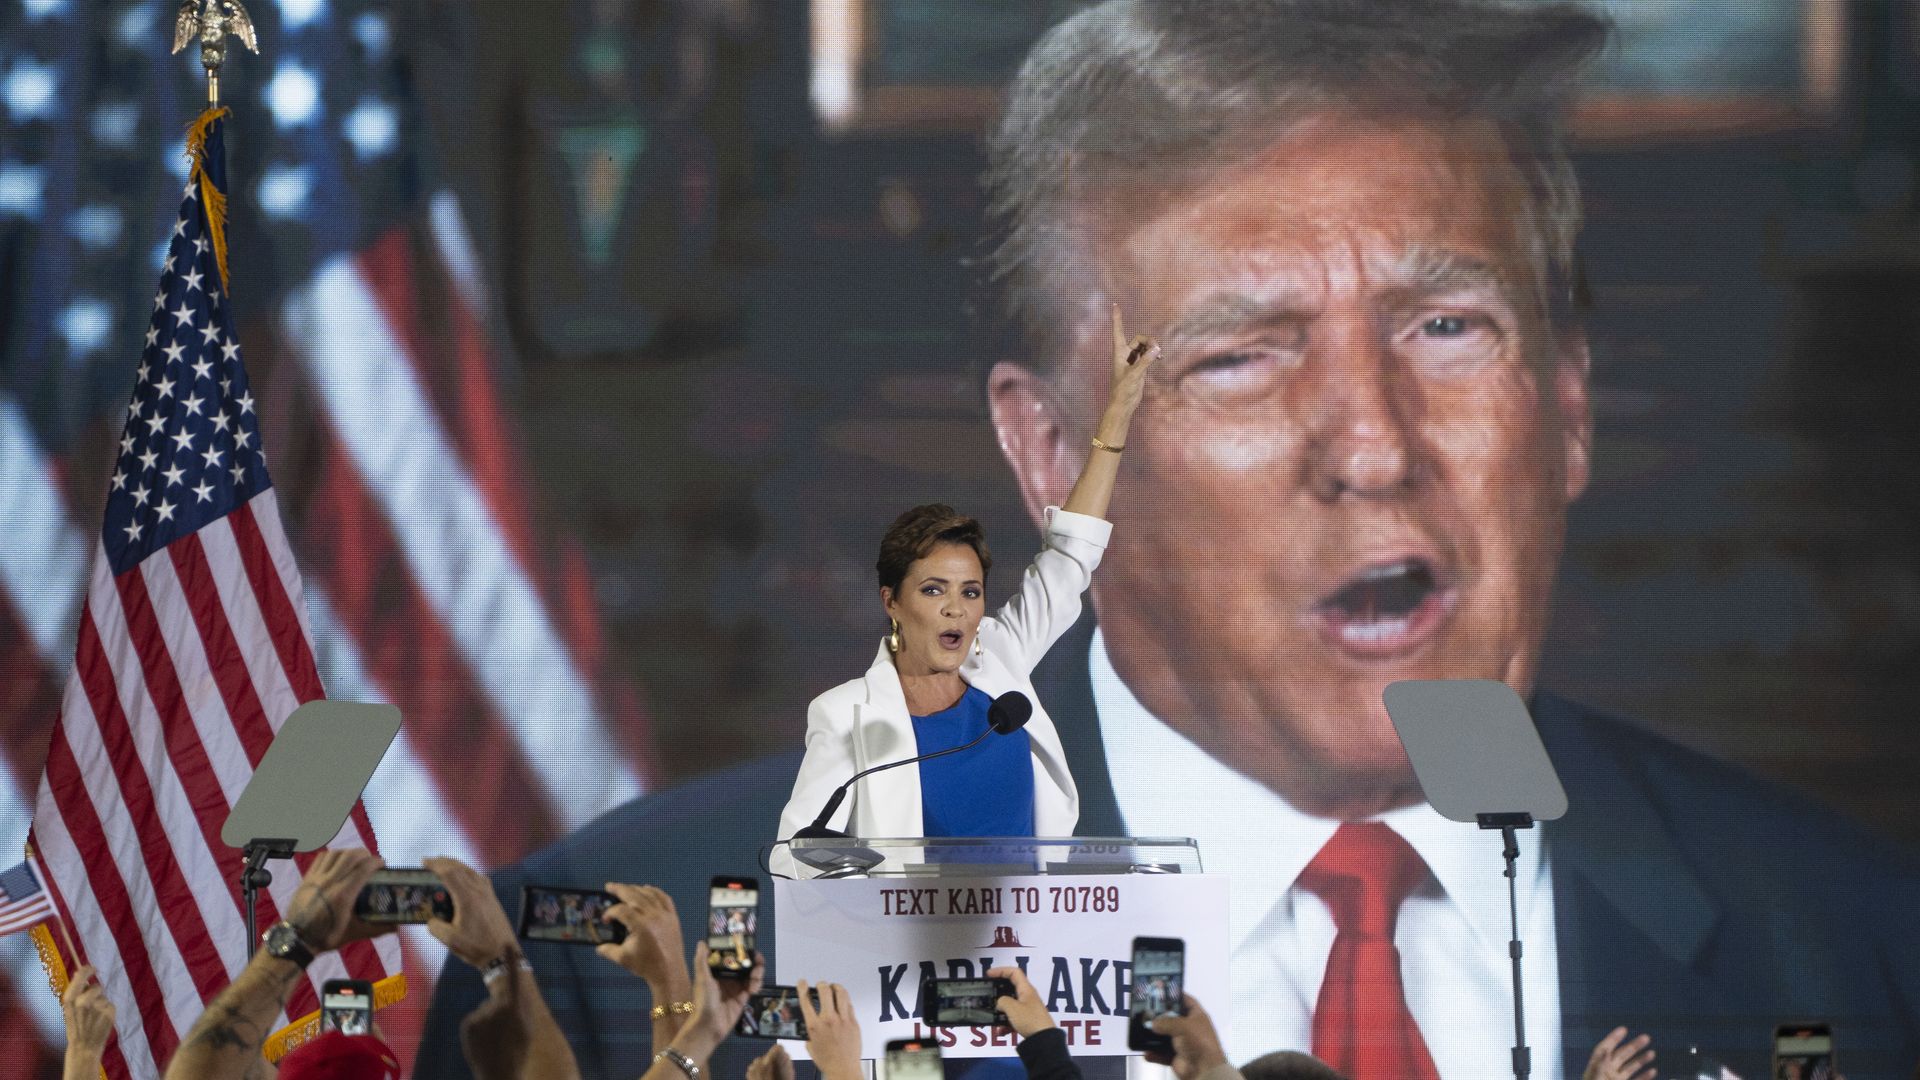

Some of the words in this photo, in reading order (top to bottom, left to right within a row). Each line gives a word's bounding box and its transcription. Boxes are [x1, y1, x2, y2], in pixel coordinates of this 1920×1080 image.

[880, 889, 938, 915] TEXT
[948, 888, 1002, 914] KARI
[1011, 887, 1039, 913] TO
[1049, 886, 1119, 912] 70789
[1015, 956, 1132, 1017] AKE
[970, 1021, 1101, 1047] SETE
